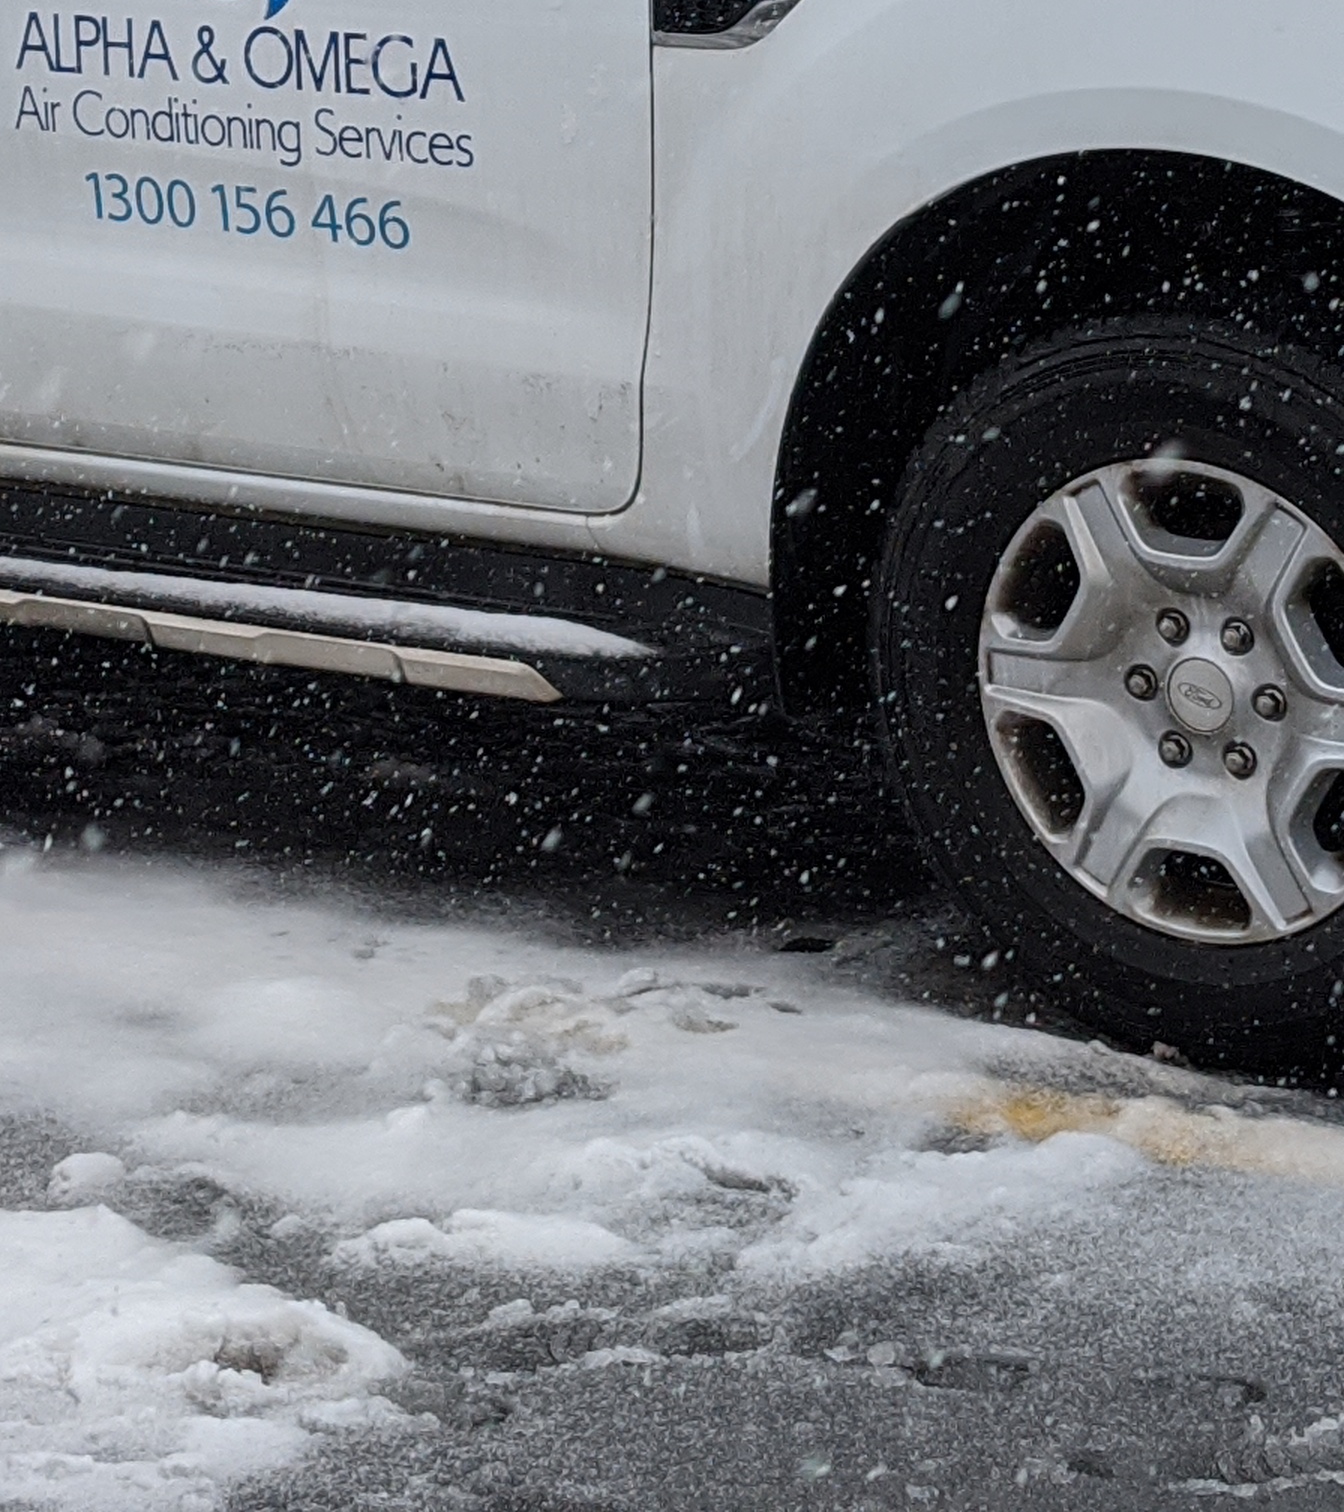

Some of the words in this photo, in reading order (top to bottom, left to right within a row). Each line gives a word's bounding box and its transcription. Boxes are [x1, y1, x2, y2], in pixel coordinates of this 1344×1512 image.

[15, 11, 179, 81] ALPHA
[191, 25, 230, 85] &
[244, 25, 467, 103] OMEGA
[14, 85, 61, 134] Air
[72, 89, 301, 166] Conditioning
[314, 107, 474, 168] Services
[84, 171, 196, 228] 1300
[210, 182, 297, 239] 156
[311, 194, 411, 251] 466
